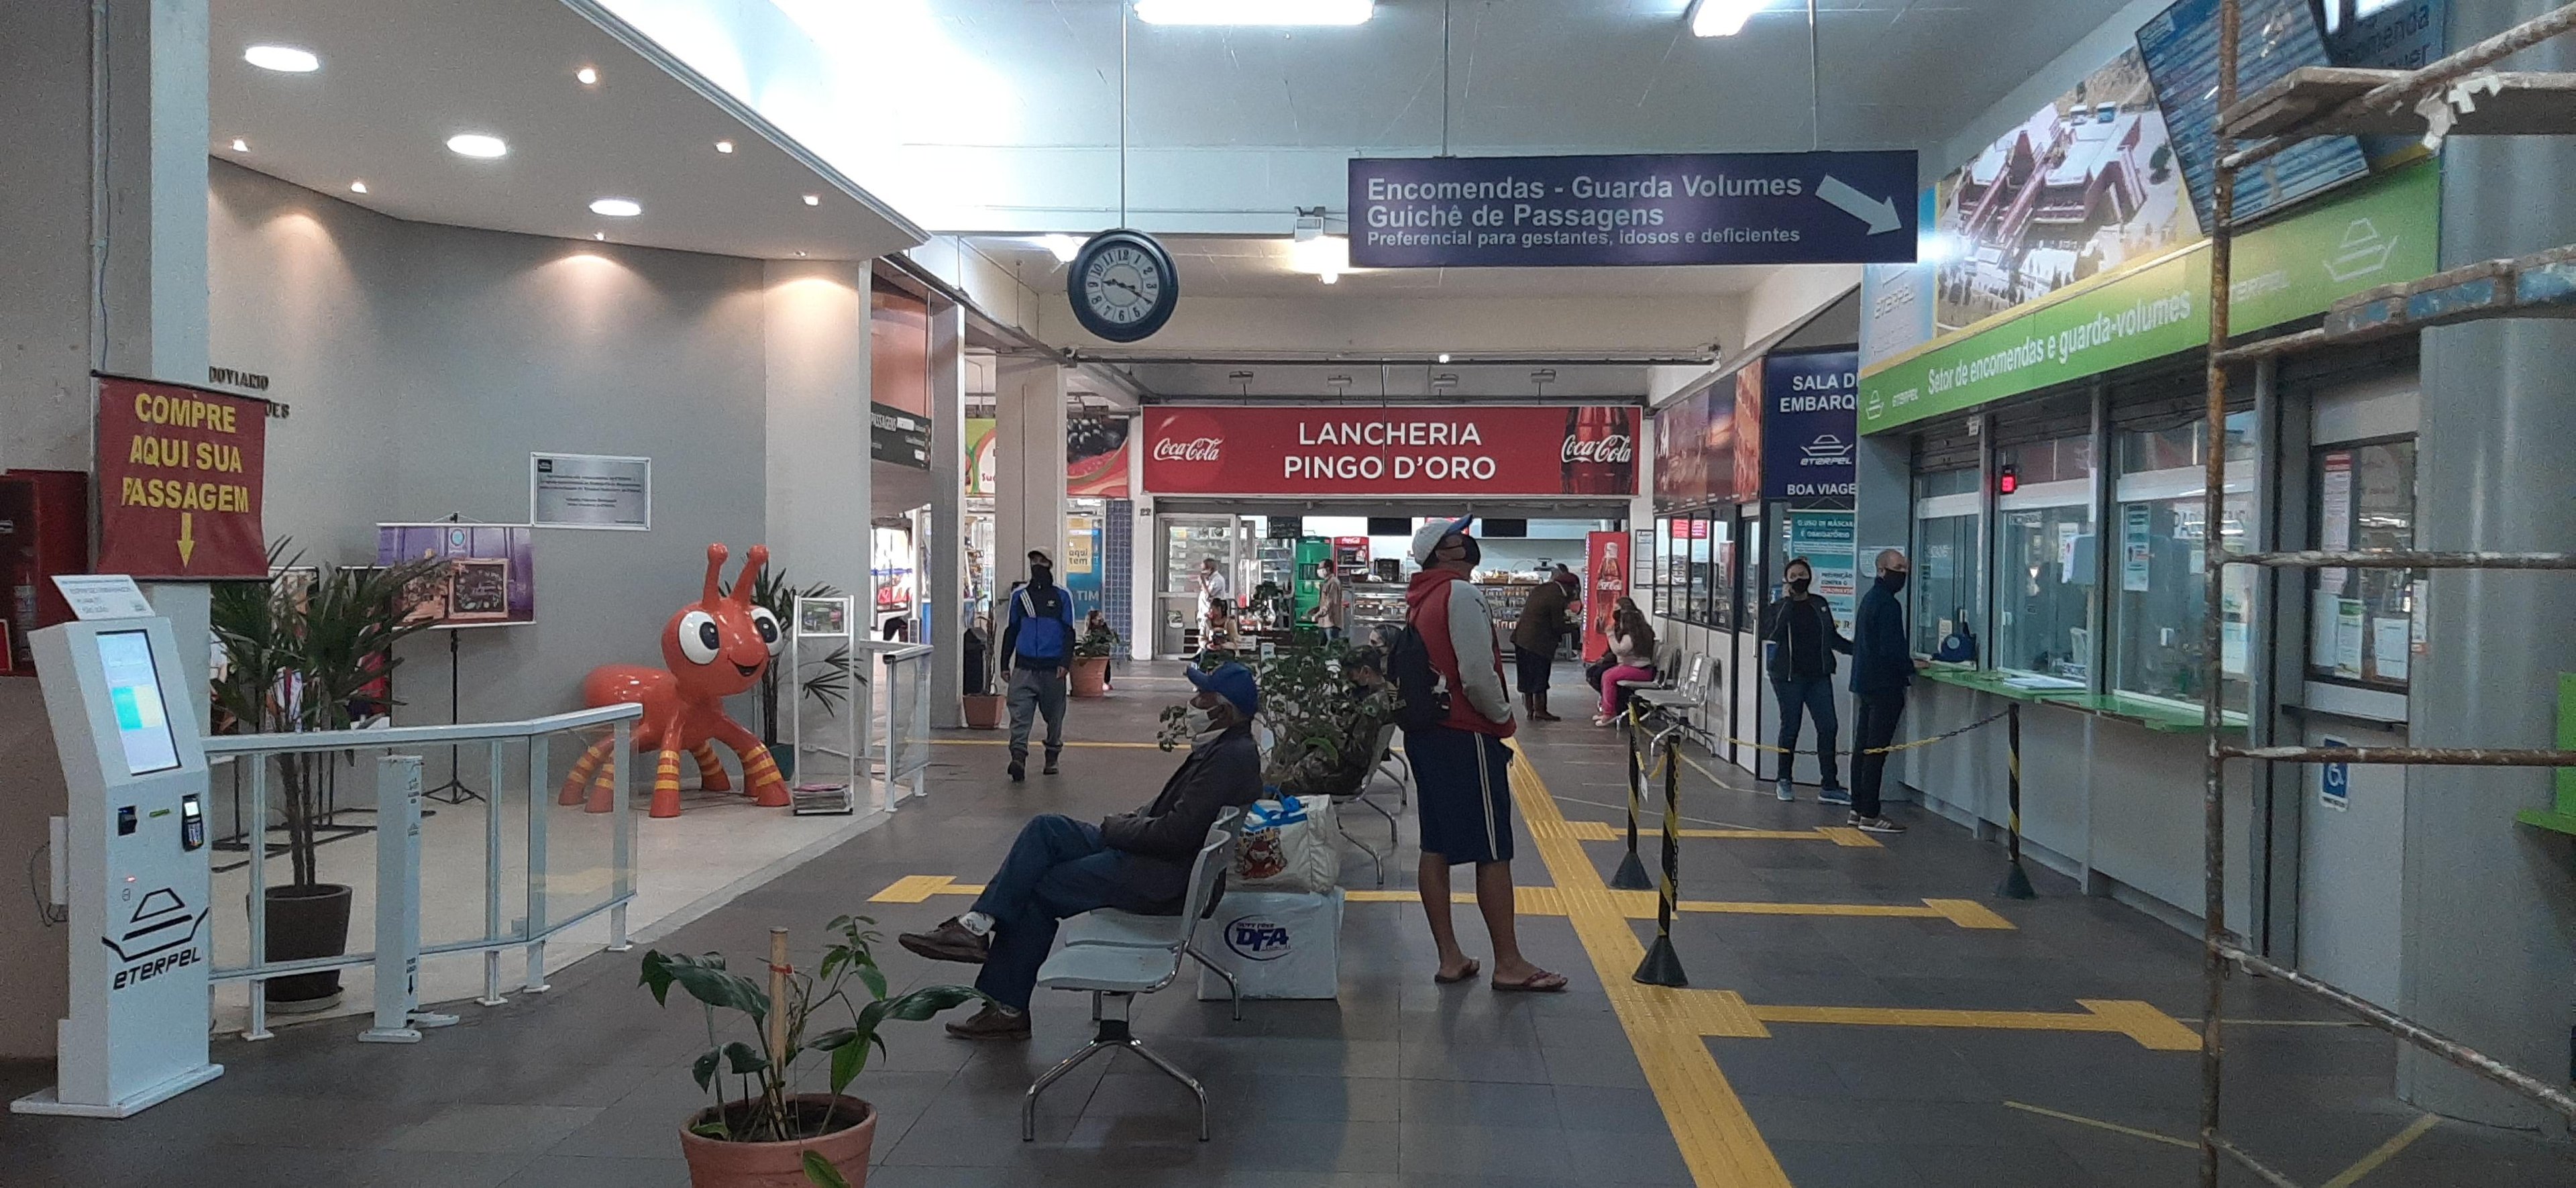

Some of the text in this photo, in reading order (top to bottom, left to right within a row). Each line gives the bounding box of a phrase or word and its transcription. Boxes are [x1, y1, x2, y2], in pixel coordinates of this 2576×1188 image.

[1367, 176, 1544, 201] Encomendas
[1572, 175, 1674, 199] Guarda
[1681, 174, 1803, 198] Volumes
[1366, 204, 1664, 231] Guichê de Passagens
[1367, 227, 1801, 248] Preferencial para gestantes, idosos e deficientes
[1102, 252, 1114, 266] 11
[1118, 250, 1129, 261] 12
[1134, 254, 1141, 264] 1
[1090, 263, 1104, 276] 10
[1142, 266, 1153, 275] 2
[1091, 296, 1102, 305] 8
[1103, 305, 1112, 316] 7
[1118, 310, 1125, 321] 6
[1132, 307, 1140, 318] 5
[1927, 289, 2192, 395] Setor de encomendas e guarda-volumes
[1792, 372, 1858, 391] SALA D
[135, 392, 236, 433] COMPRE
[1780, 394, 1858, 413] EMBARQ
[1299, 422, 1482, 445] LANCHERIA
[129, 435, 243, 474] AQUI SUA
[1153, 437, 1224, 462] Coca-Cola
[1560, 434, 1631, 464] Coca-Cola
[1283, 455, 1497, 480] PINGO D'ORO
[121, 477, 250, 513] PASSAGEM
[1786, 484, 1815, 496] BOA
[1077, 591, 1099, 601] TIM
[1236, 927, 1289, 951] DFA
